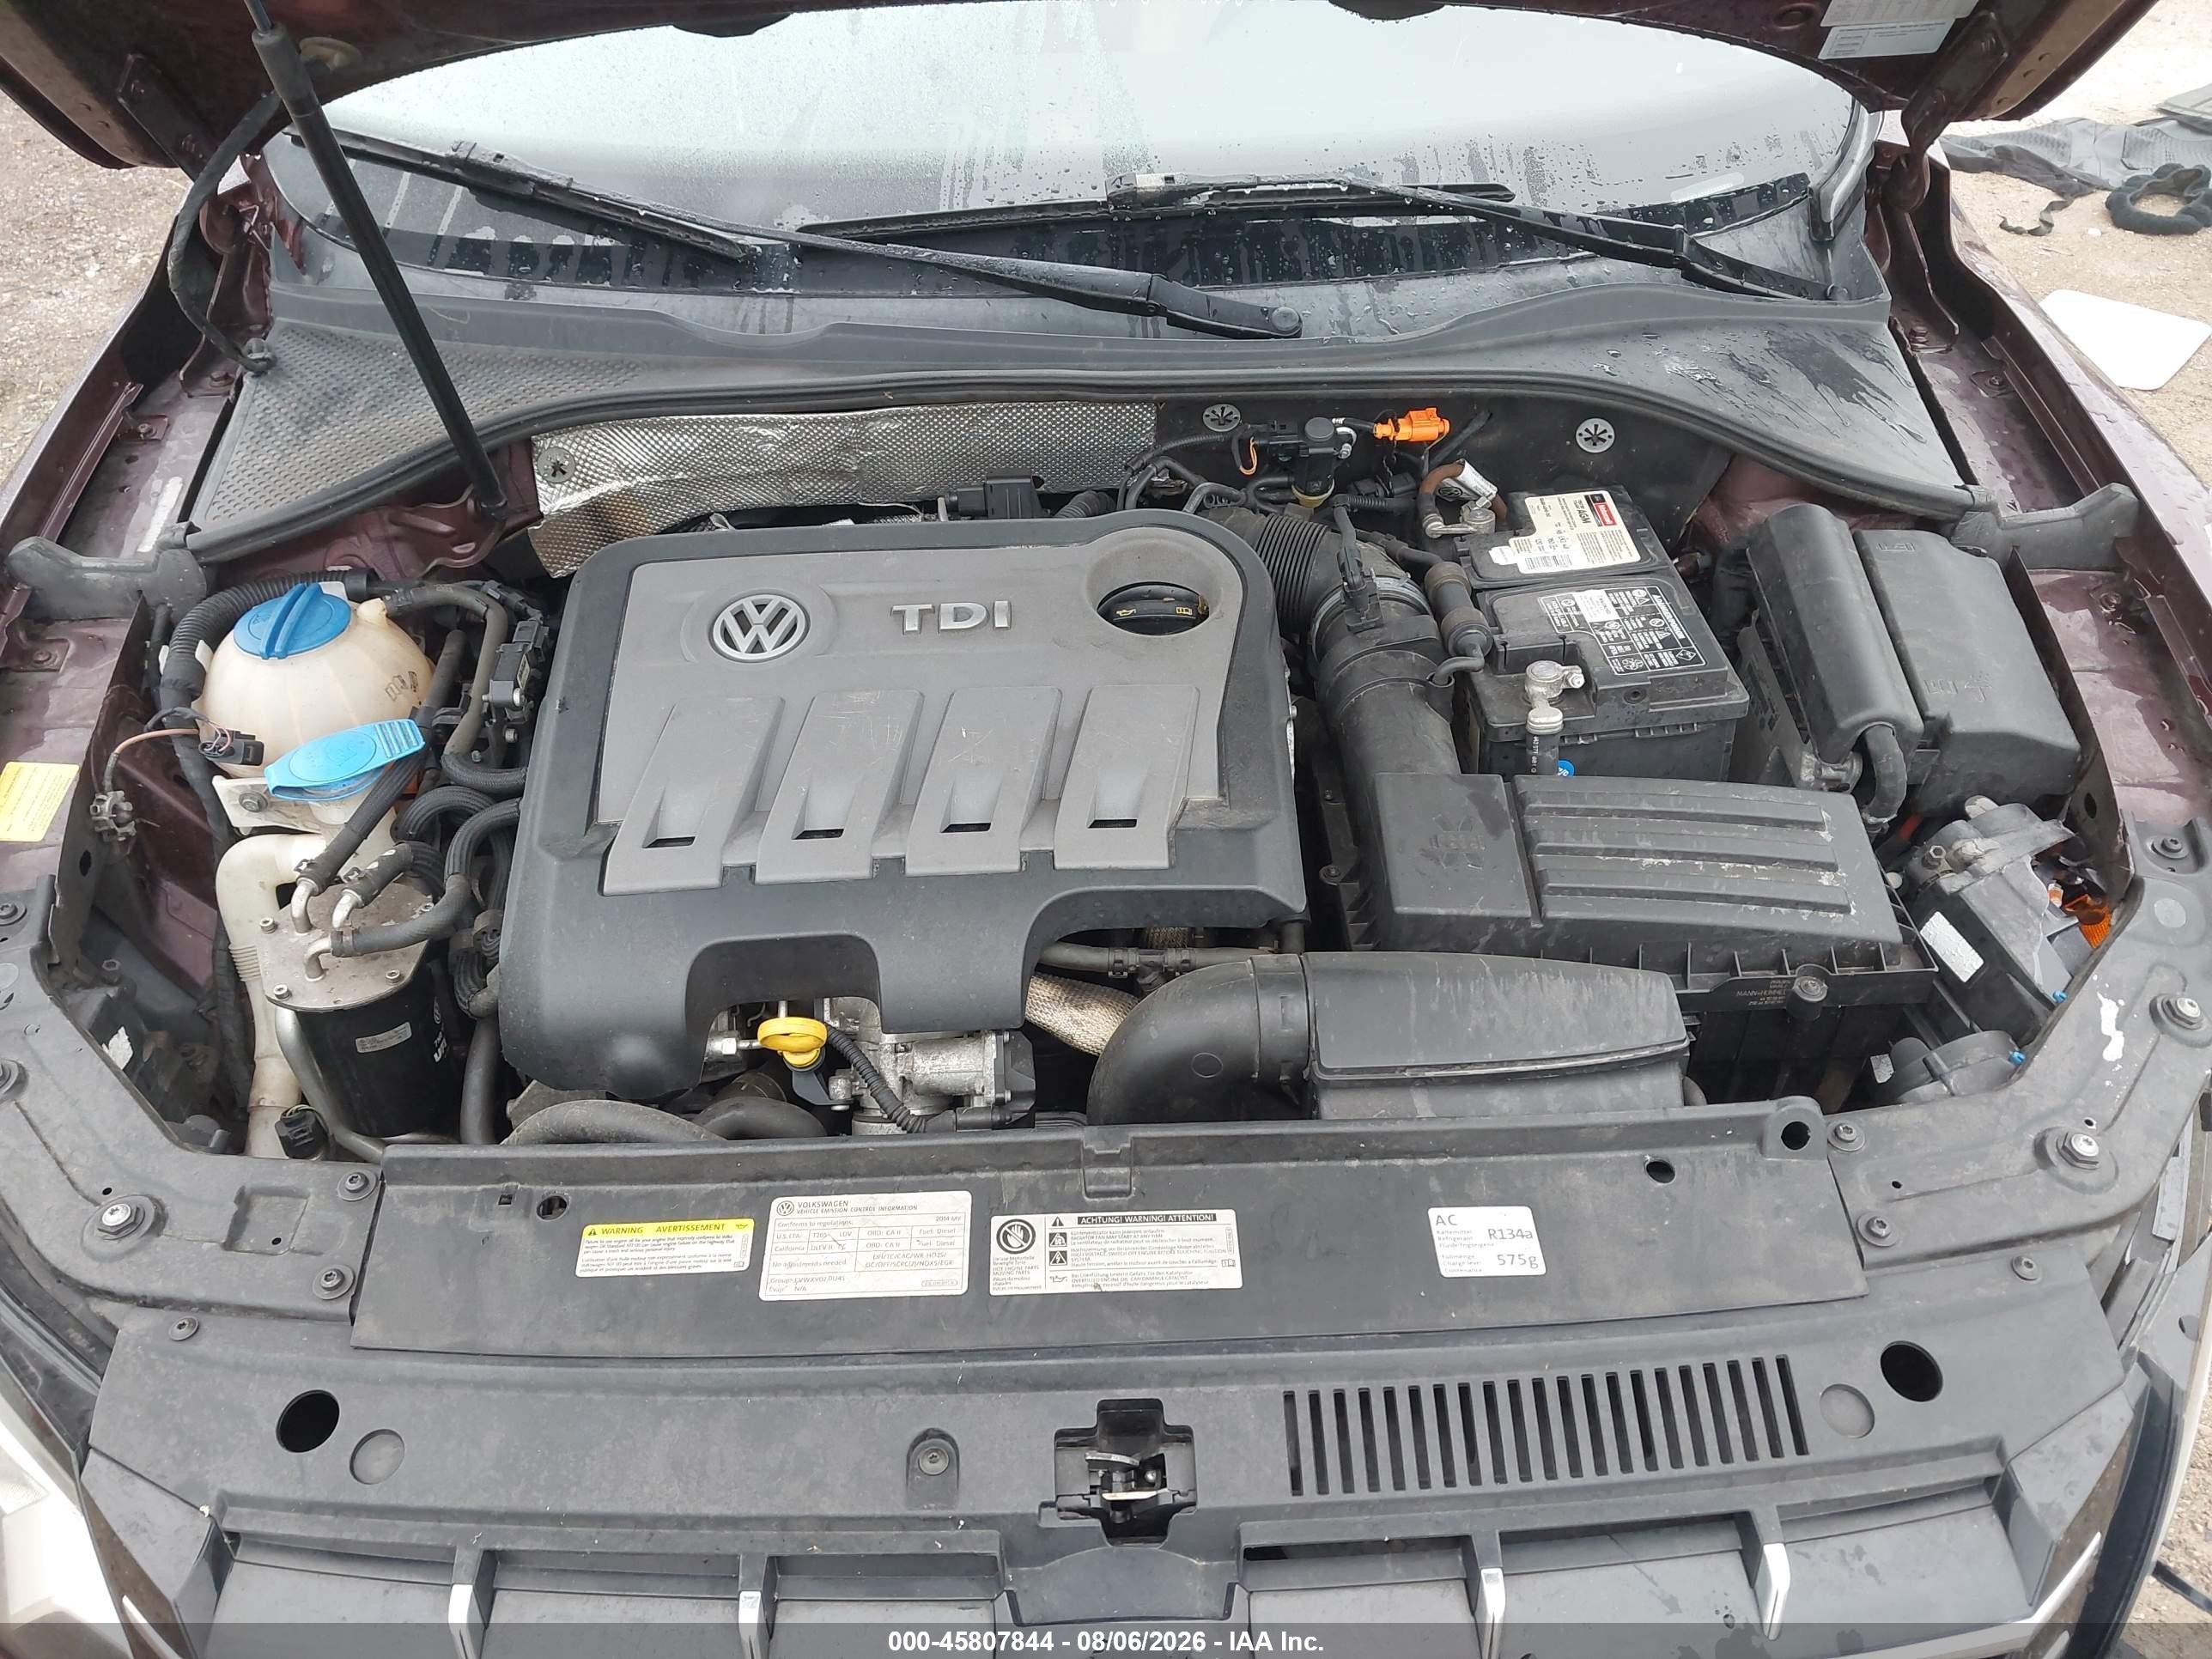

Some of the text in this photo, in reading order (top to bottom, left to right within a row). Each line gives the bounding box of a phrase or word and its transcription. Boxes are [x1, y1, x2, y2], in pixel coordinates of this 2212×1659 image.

[890, 599, 1012, 634] TDI
[711, 593, 810, 663] VW
[797, 1200, 849, 1208] VOLKSWAGEN
[1080, 1216, 1122, 1224] ACHTUNG!
[1168, 1214, 1214, 1222] ATTENTION!
[1435, 1214, 1457, 1226] AC
[601, 1224, 726, 1235] WARNING AVERTISSEMENT
[1488, 1228, 1533, 1240] R134a
[1497, 1254, 1539, 1269] 575g
